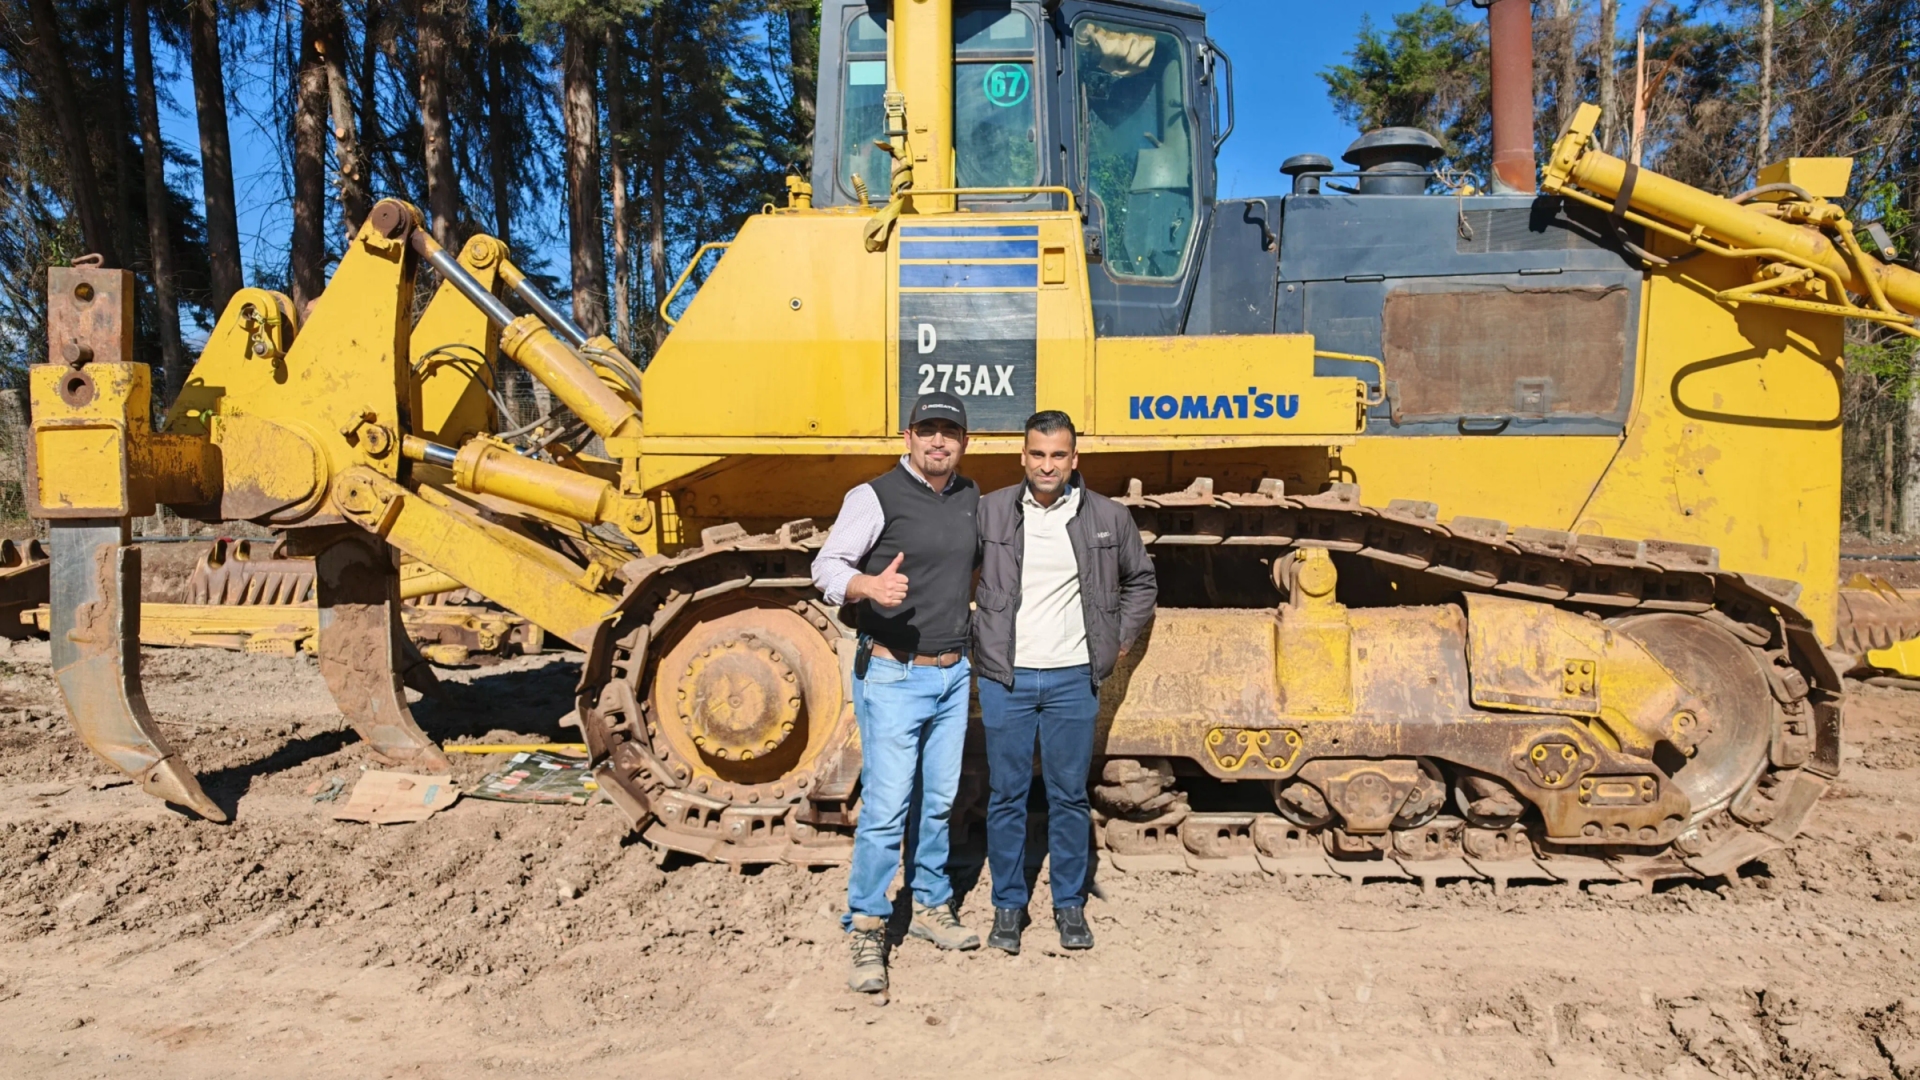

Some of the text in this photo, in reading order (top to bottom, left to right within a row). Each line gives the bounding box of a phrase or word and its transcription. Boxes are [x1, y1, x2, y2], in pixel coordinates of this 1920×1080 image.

[991, 71, 1022, 98] 67
[918, 323, 937, 354] D
[918, 363, 1015, 396] 275AX
[1129, 386, 1299, 420] KOMATSU
